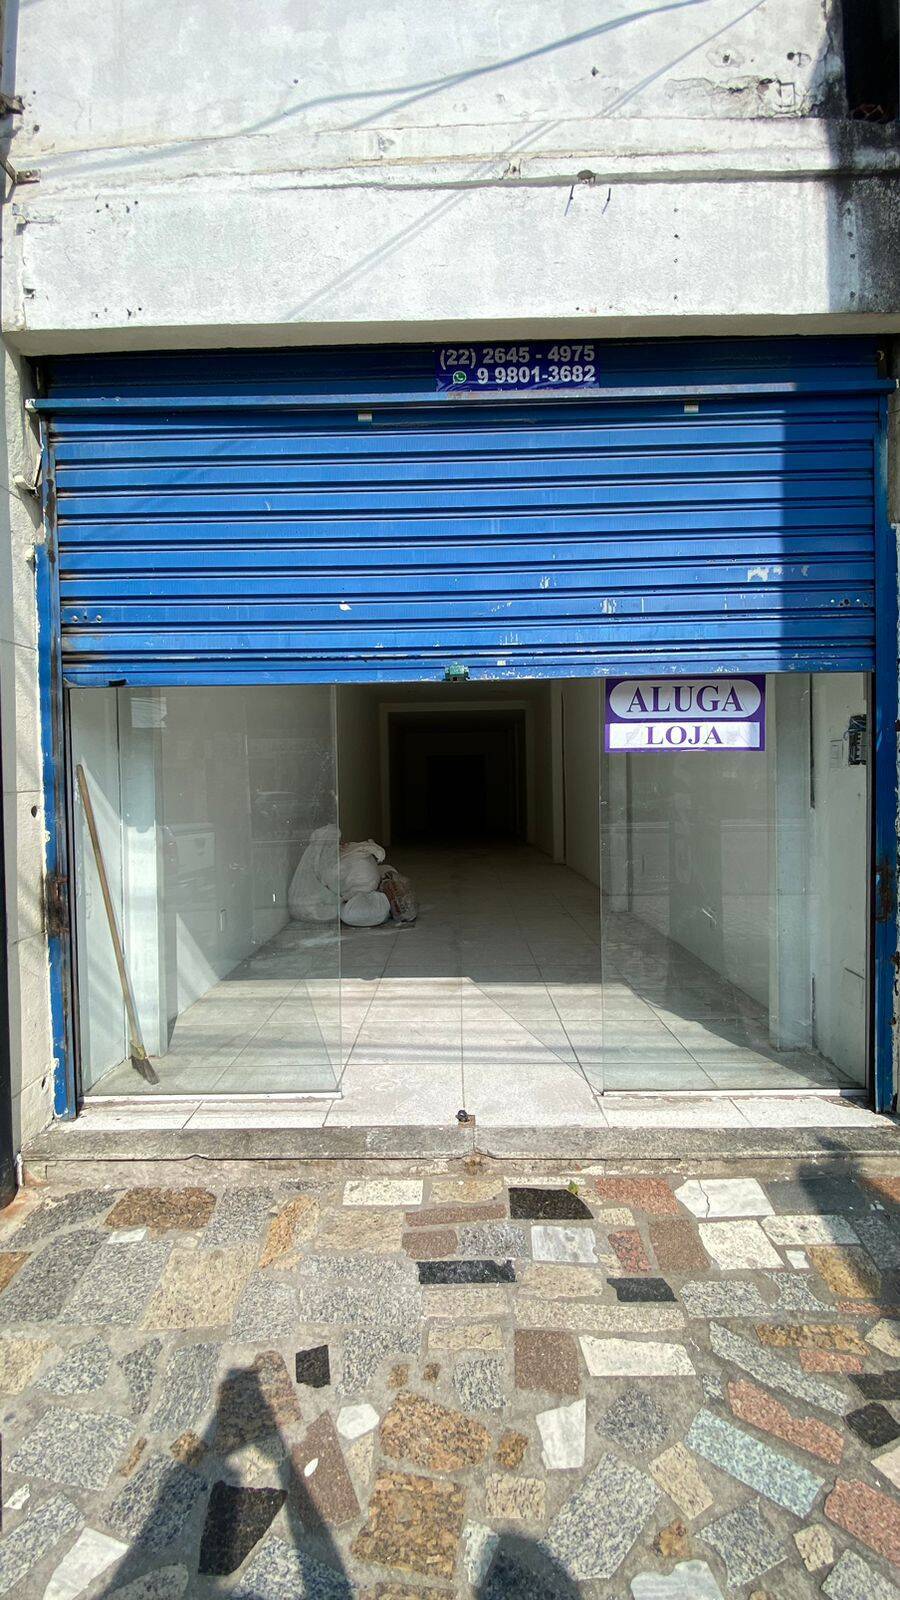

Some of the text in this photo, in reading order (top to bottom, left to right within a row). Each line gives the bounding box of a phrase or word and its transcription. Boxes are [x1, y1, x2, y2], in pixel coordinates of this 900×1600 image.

[440, 349, 476, 370] (22)
[483, 347, 530, 364] 2645
[547, 345, 595, 362] 4975
[477, 365, 596, 384] 9 9801-3682
[626, 685, 744, 713] ALUGA
[646, 725, 723, 745] LOJA
